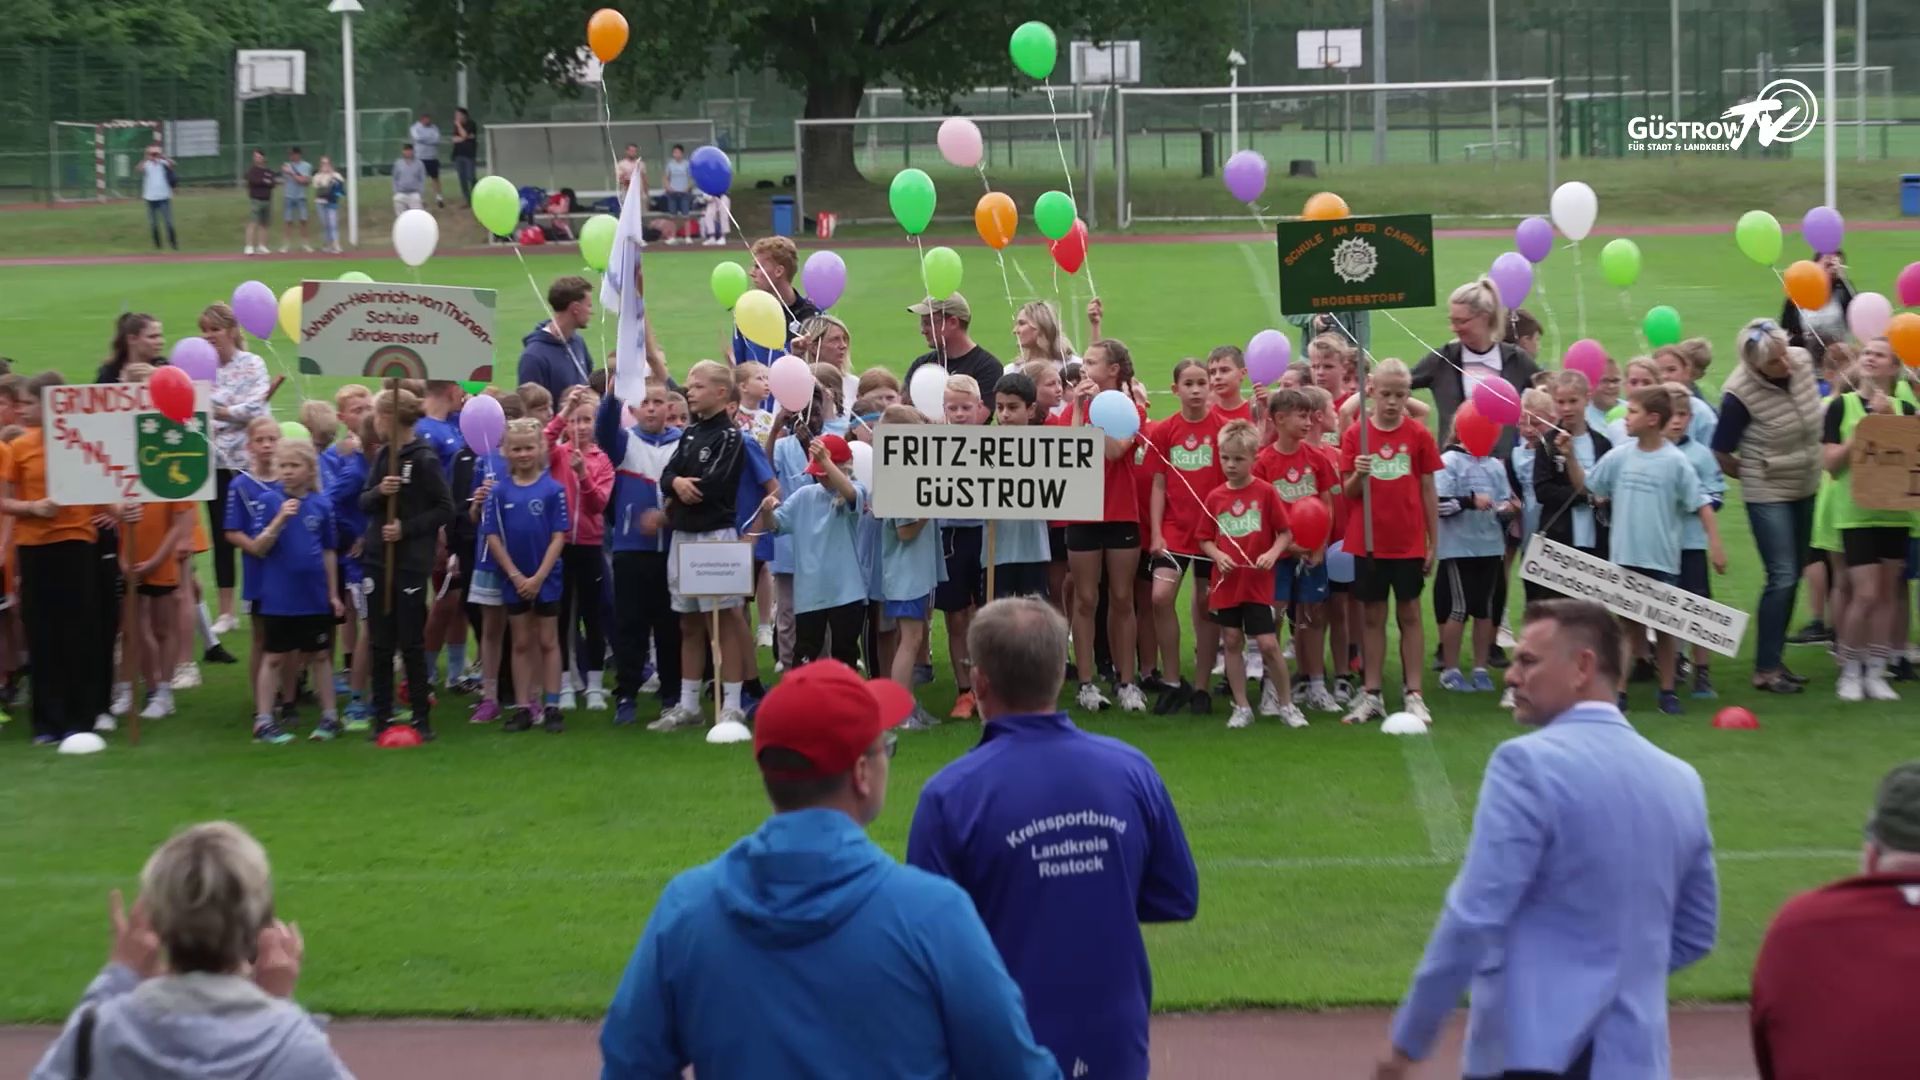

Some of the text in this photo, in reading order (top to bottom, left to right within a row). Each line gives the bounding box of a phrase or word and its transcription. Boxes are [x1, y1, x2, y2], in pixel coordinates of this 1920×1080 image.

[1284, 233, 1324, 266] SCHULE
[1332, 225, 1348, 237] AN
[1354, 223, 1377, 233] DER
[365, 310, 419, 325] Schule
[346, 328, 440, 345] Jördenstorf
[50, 386, 153, 414] GRUNDSC
[52, 418, 142, 498] SANITZ
[883, 435, 1094, 469] FRITZ-REUTER
[1172, 450, 1211, 465] Karls
[1540, 543, 1733, 627] Regionale Schule Zehna
[1524, 559, 1737, 650] Grundschulteil Mühl Rosin
[1006, 809, 1127, 848] Kreissportbund
[1031, 836, 1109, 860] Landkreis
[1038, 855, 1104, 878] Rostock
